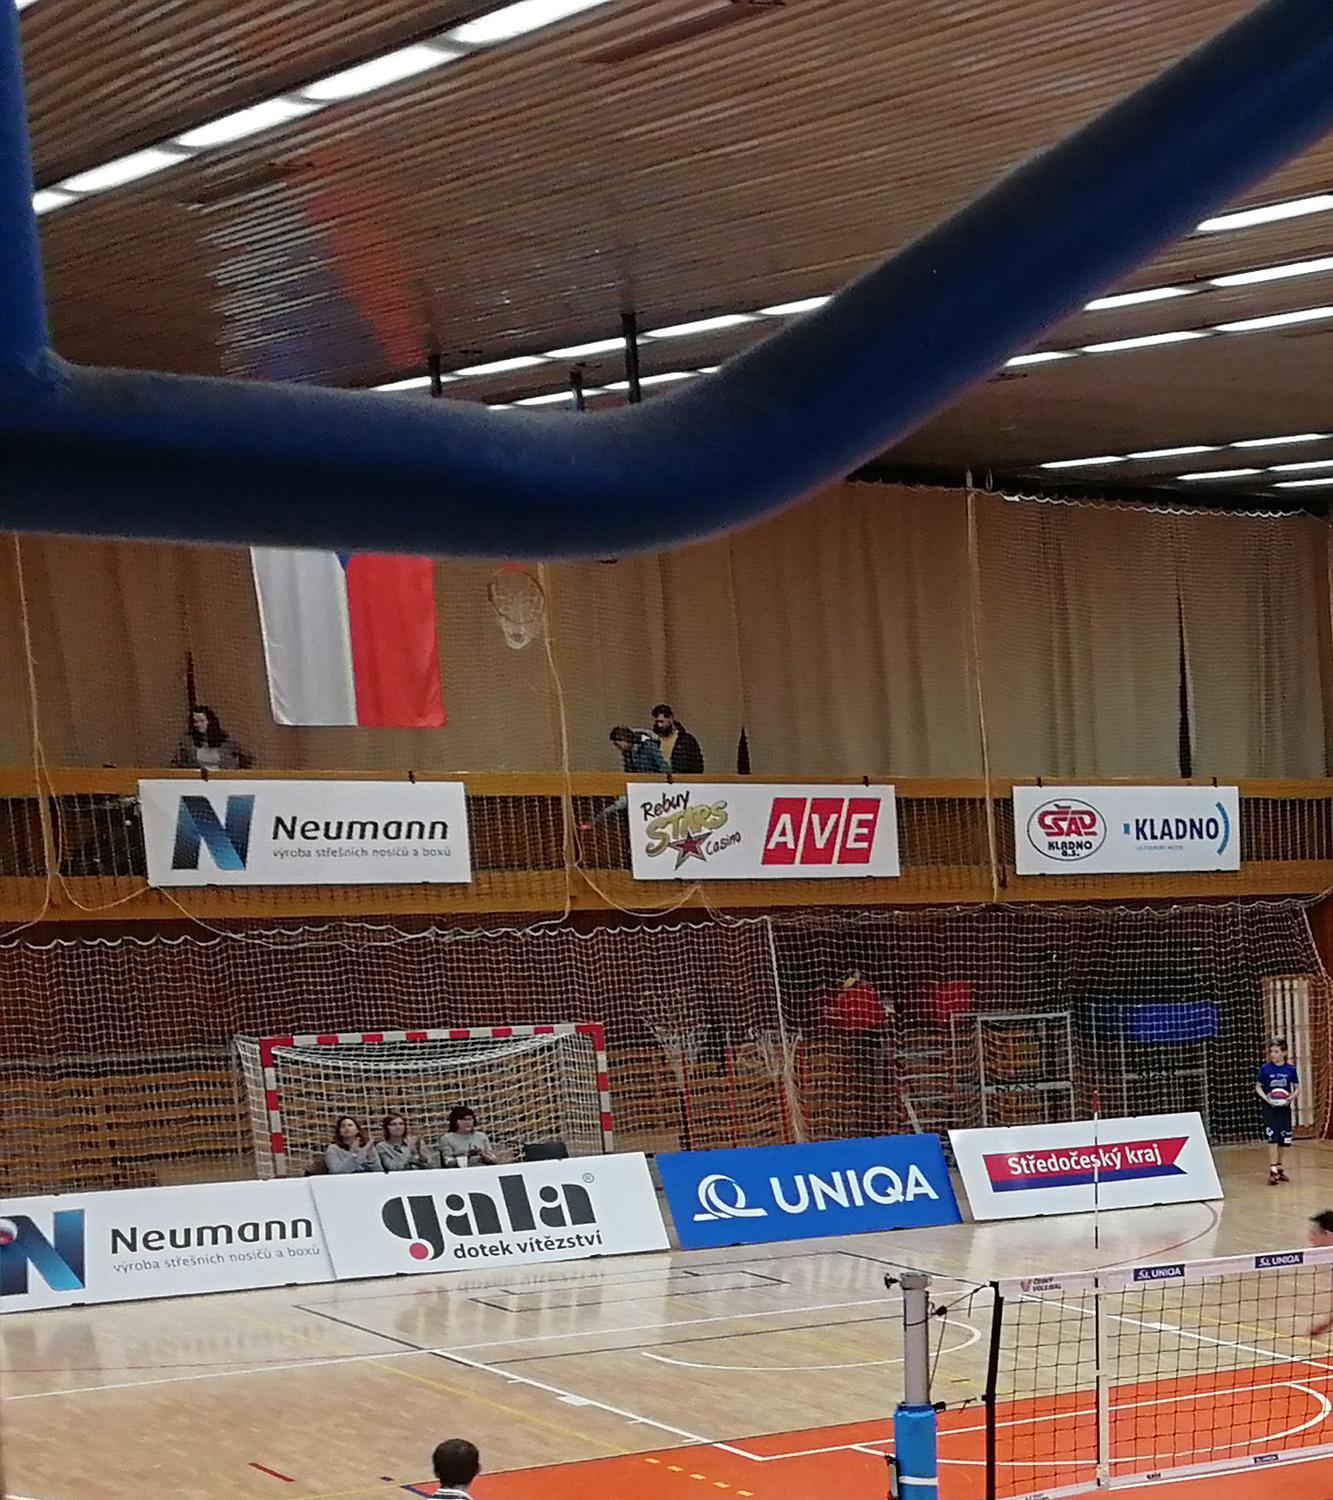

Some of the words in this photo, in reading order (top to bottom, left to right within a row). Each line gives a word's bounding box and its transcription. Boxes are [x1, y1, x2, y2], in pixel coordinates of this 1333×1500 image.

[640, 790, 690, 821] Rebuy
[272, 816, 449, 841] Neumann
[645, 800, 728, 857] STARS
[706, 831, 742, 856] Casino
[767, 813, 874, 849] AVE
[1135, 817, 1219, 840] KLADNO
[273, 846, 312, 859] výroba
[316, 845, 368, 857] střešních
[372, 845, 409, 857] nosičů
[413, 848, 420, 857] a
[423, 846, 451, 857] boxů
[1048, 841, 1092, 850] KLADNO
[1007, 1147, 1122, 1175] Středočeský
[1126, 1143, 1162, 1165] kraj
[769, 1164, 939, 1214] UNIQA
[381, 1174, 597, 1260] gala
[111, 1217, 313, 1254] Neumann
[454, 1239, 513, 1259] dotek
[516, 1230, 603, 1254] vítězství
[113, 1258, 161, 1275] výroba
[164, 1253, 225, 1269] střešních
[229, 1248, 272, 1262] nosičů
[276, 1250, 284, 1258] a
[288, 1243, 320, 1257] boxů
[1151, 1266, 1182, 1279] UNIQA
